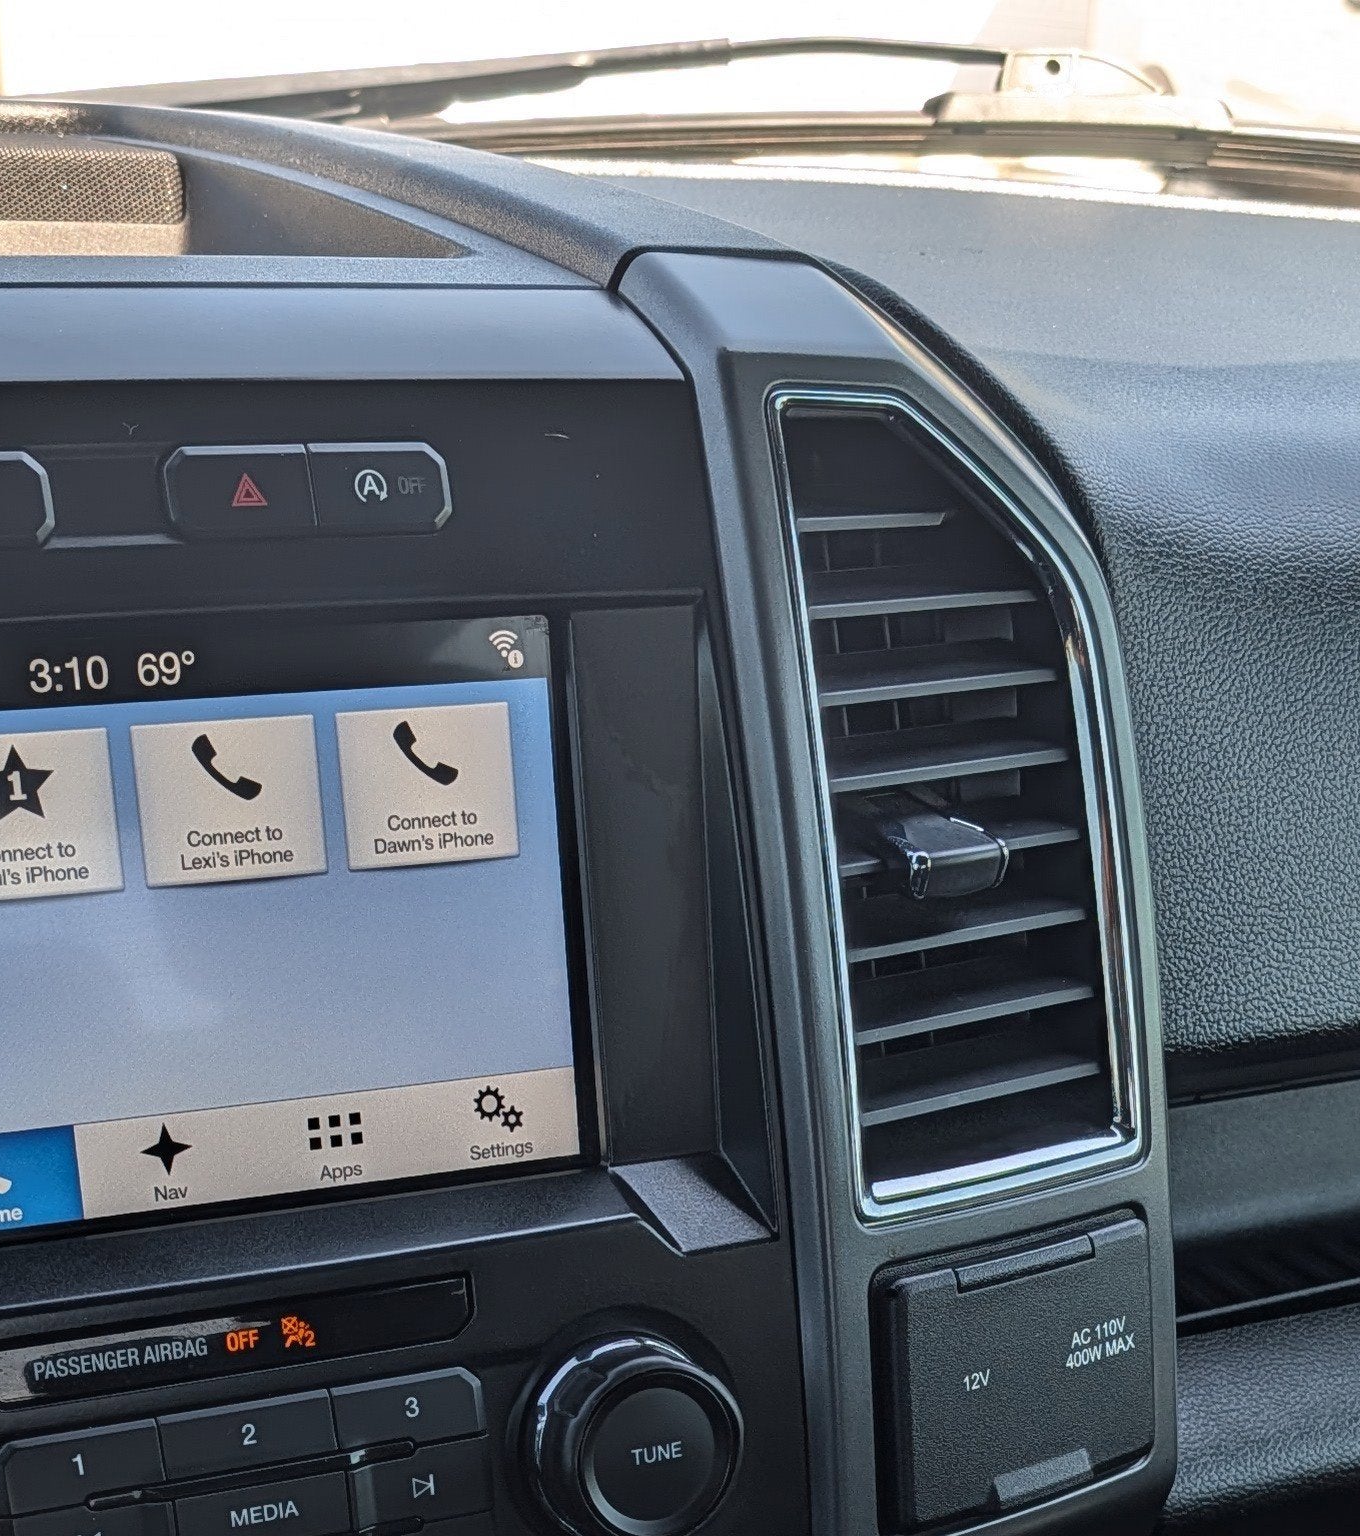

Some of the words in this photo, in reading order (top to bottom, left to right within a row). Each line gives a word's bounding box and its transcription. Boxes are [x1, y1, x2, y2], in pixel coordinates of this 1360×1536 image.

[397, 476, 426, 495] OFF
[29, 655, 109, 694] 3:10
[137, 650, 195, 687] 69°
[7, 770, 28, 801] 1
[386, 813, 457, 832] Connect
[459, 810, 478, 826] to
[187, 827, 260, 848] Connect
[264, 825, 283, 842] to
[373, 834, 434, 855] Dawn's
[437, 831, 494, 850] iPhone
[56, 841, 76, 858] to
[180, 851, 230, 871] Lexi's
[233, 848, 295, 867] iPhone
[25, 865, 90, 884] iPhone
[469, 1141, 534, 1162] Settings
[320, 1164, 363, 1183] Apps
[153, 1185, 188, 1203] Nav
[1071, 1328, 1092, 1346] AC
[1094, 1316, 1126, 1341] 110V
[33, 1347, 140, 1381] PASSENGER
[143, 1337, 208, 1365] AIRBAG
[226, 1329, 259, 1352] OFF
[1066, 1344, 1103, 1370] 400W
[1106, 1333, 1136, 1358] MAX
[963, 1369, 991, 1392] 12V
[404, 1396, 420, 1418] 3
[241, 1423, 258, 1446] 2
[631, 1440, 683, 1465] TUNE
[71, 1453, 85, 1476] 1
[230, 1500, 300, 1528] MEDIA
